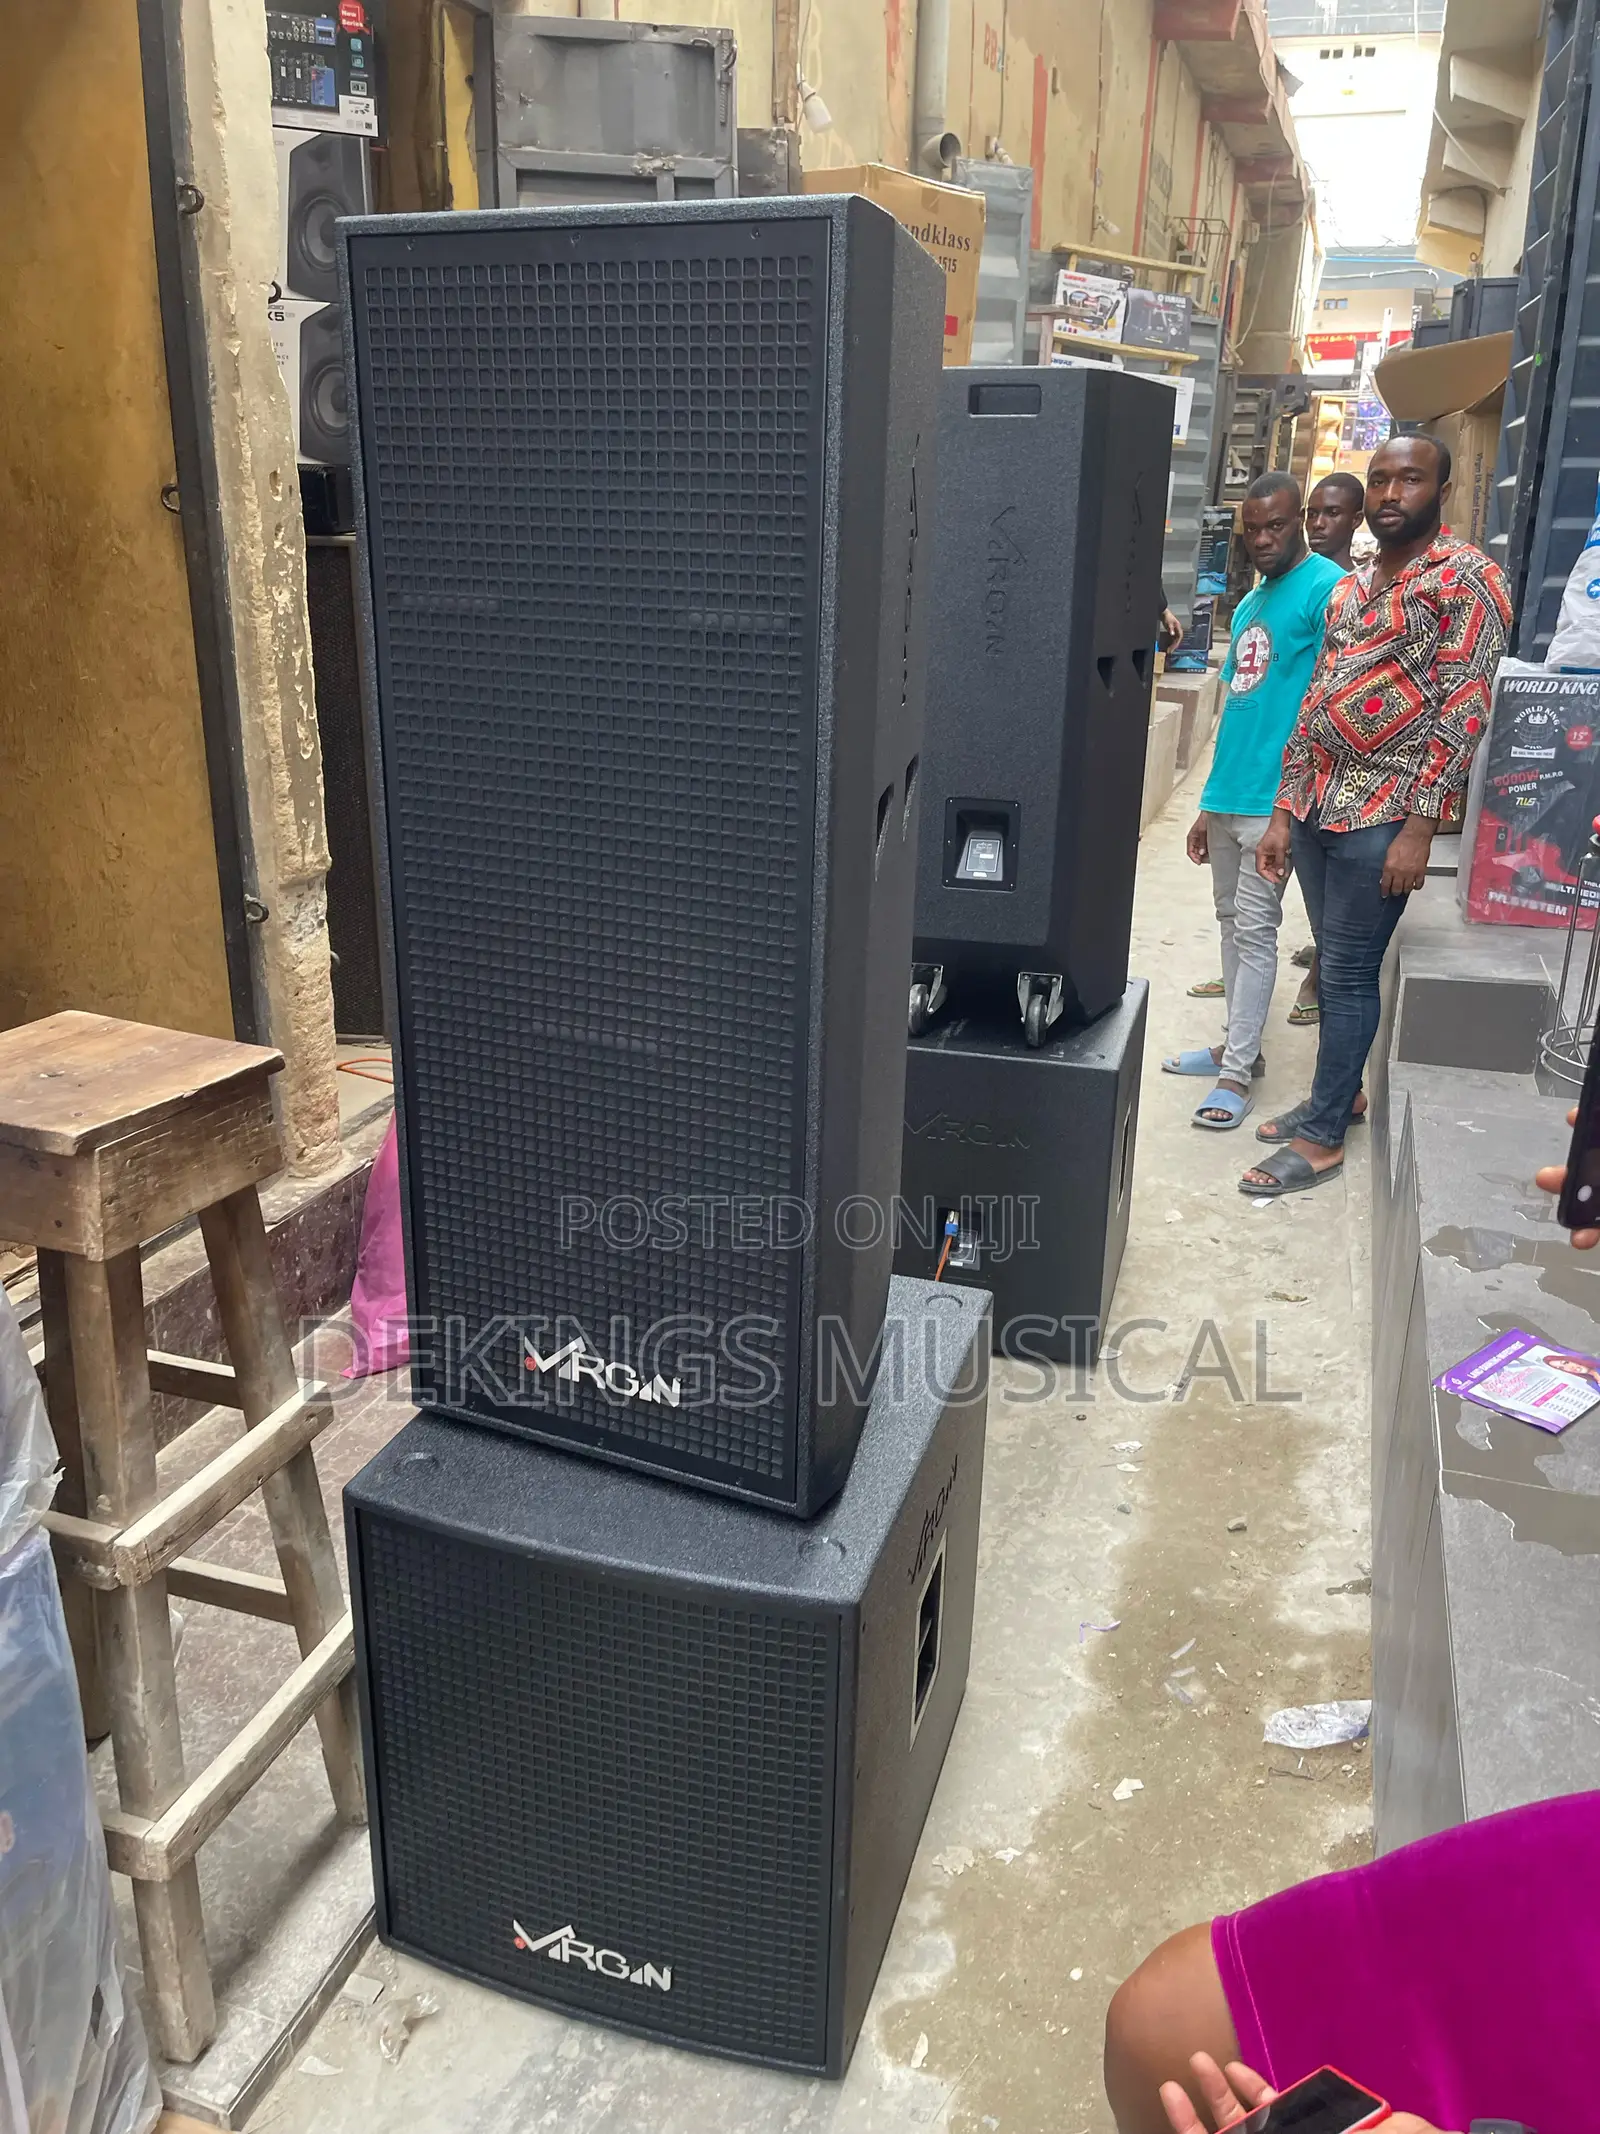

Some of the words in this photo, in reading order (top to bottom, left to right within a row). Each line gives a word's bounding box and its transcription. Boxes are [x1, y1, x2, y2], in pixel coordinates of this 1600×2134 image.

[903, 222, 971, 252] ndklass
[1503, 680, 1559, 694] WORLD
[1559, 682, 1599, 695] KING
[1513, 705, 1543, 724] WORLD
[1544, 707, 1560, 726] KING
[1508, 782, 1538, 794] POWER
